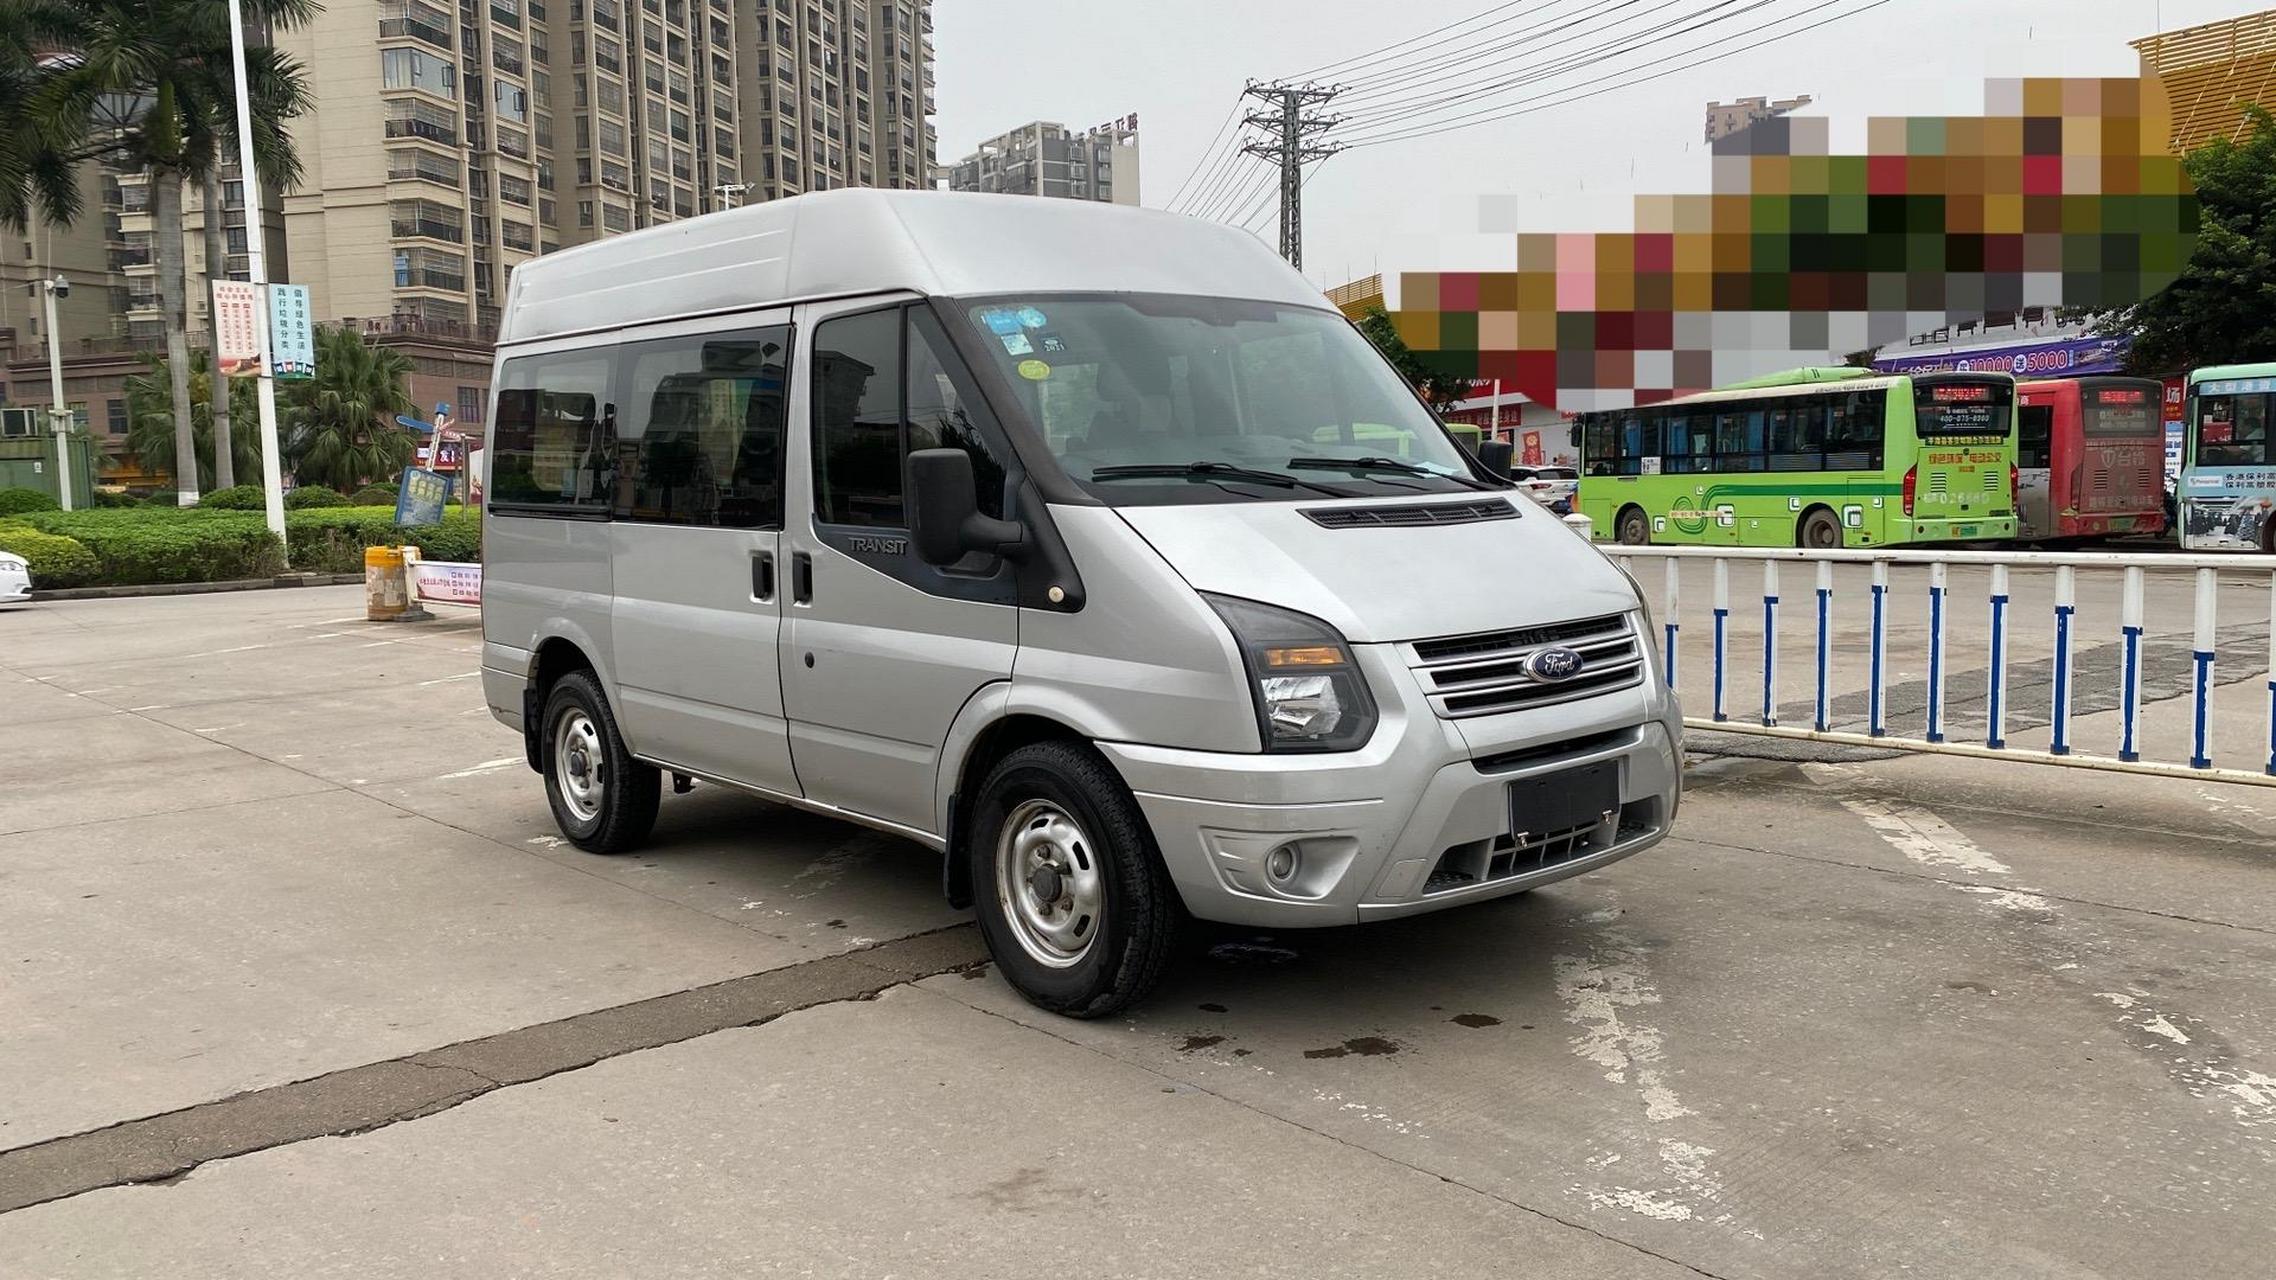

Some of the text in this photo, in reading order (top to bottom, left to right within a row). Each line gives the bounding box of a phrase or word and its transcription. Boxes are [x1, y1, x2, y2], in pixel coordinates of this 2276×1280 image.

[277, 287, 289, 350] 践行垃圾分类
[294, 289, 306, 350] 倡导绿色生活
[2166, 387, 2180, 403] 场
[848, 537, 907, 554] TRANSIT
[1545, 652, 1575, 675] Ford
